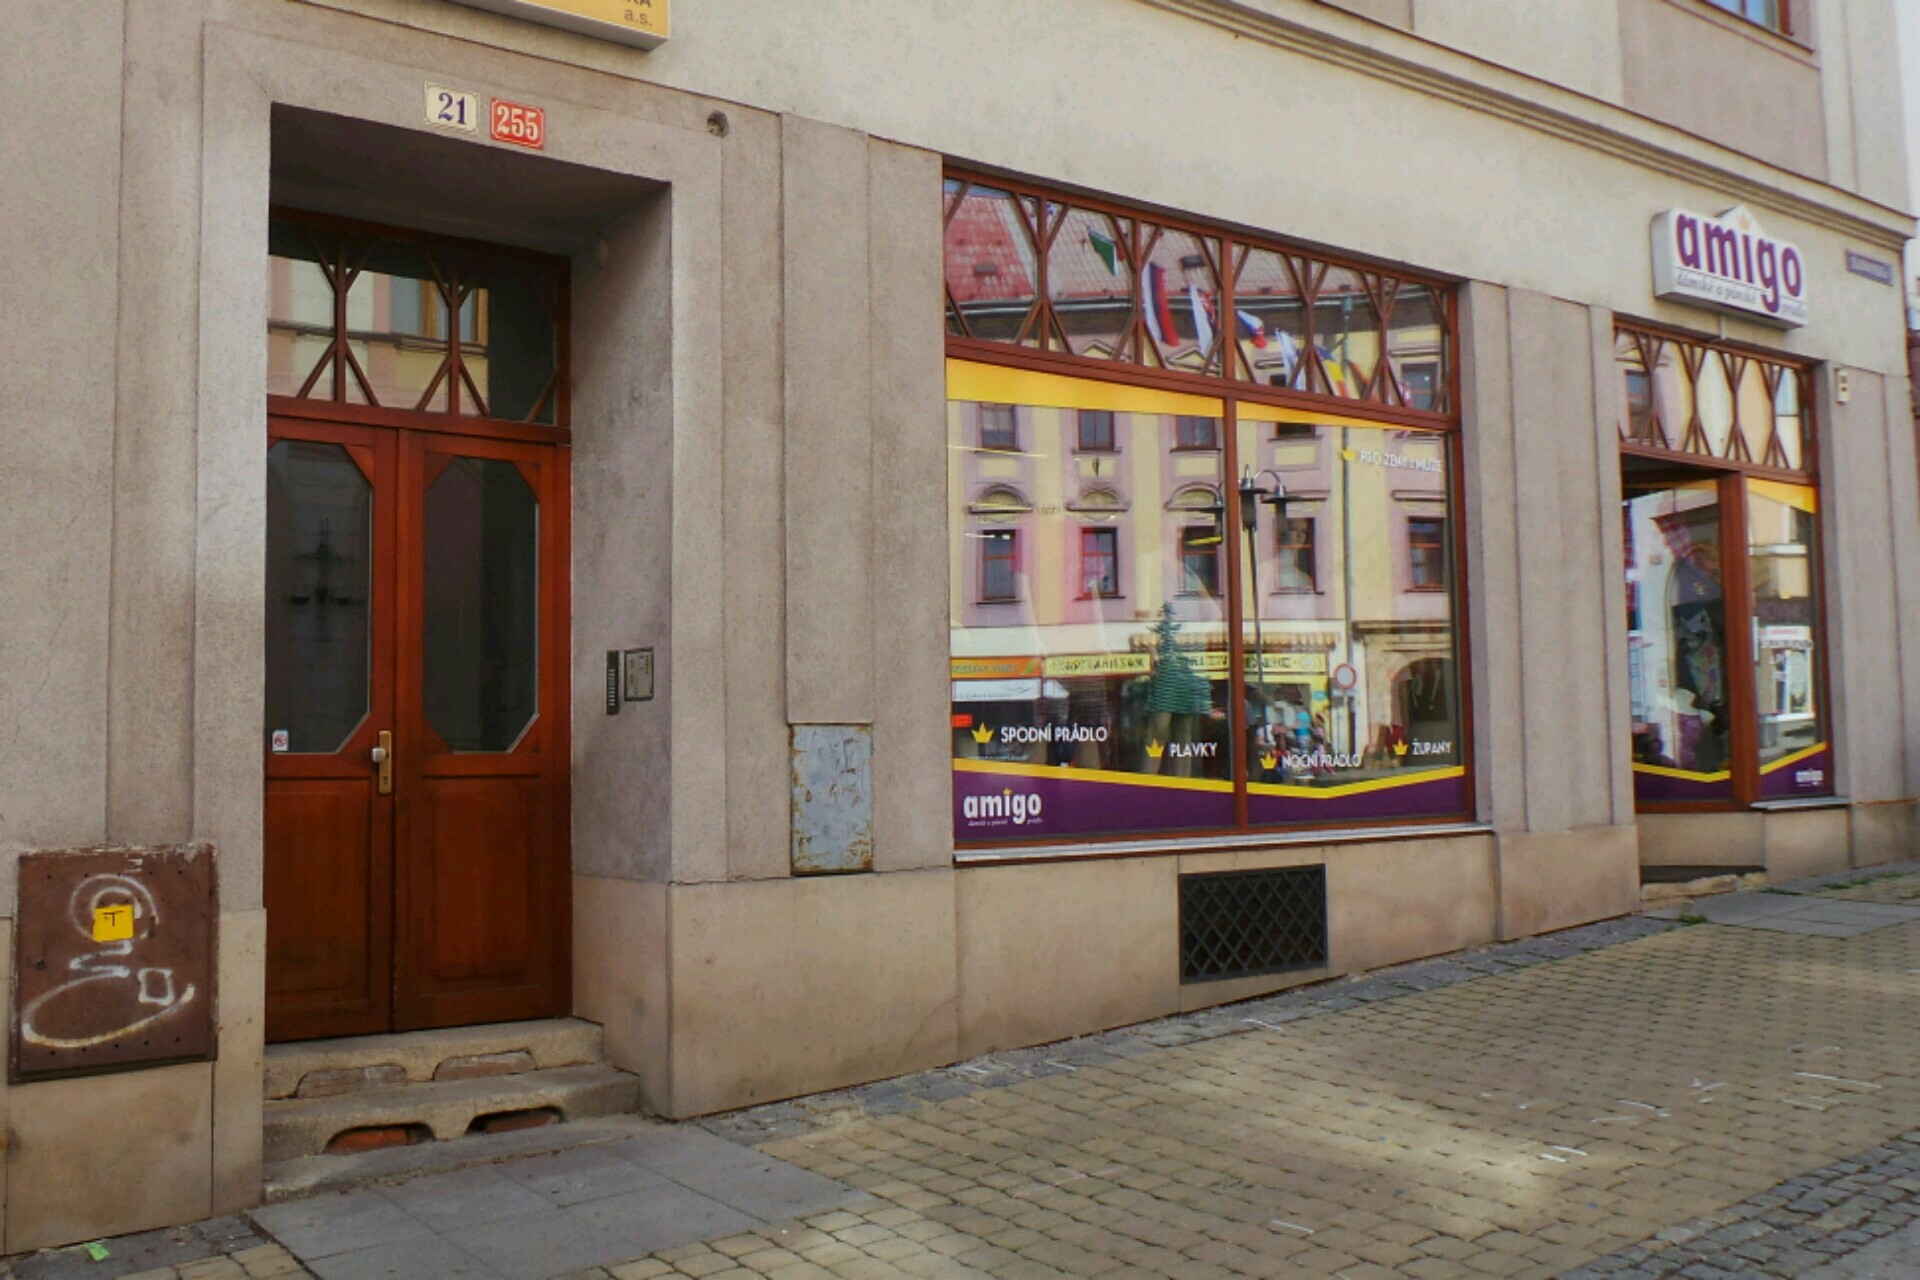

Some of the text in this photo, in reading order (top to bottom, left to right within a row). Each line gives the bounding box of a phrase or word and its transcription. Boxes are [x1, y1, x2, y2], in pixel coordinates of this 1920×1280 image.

[624, 9, 653, 27] a.s.
[438, 91, 467, 125] 21
[496, 105, 539, 141] 255
[1676, 213, 1802, 313] amigo
[1000, 722, 1107, 743] SPODNÍ PRÁDLO
[1169, 742, 1218, 759] PLAVKY
[963, 789, 1042, 825] amigo
